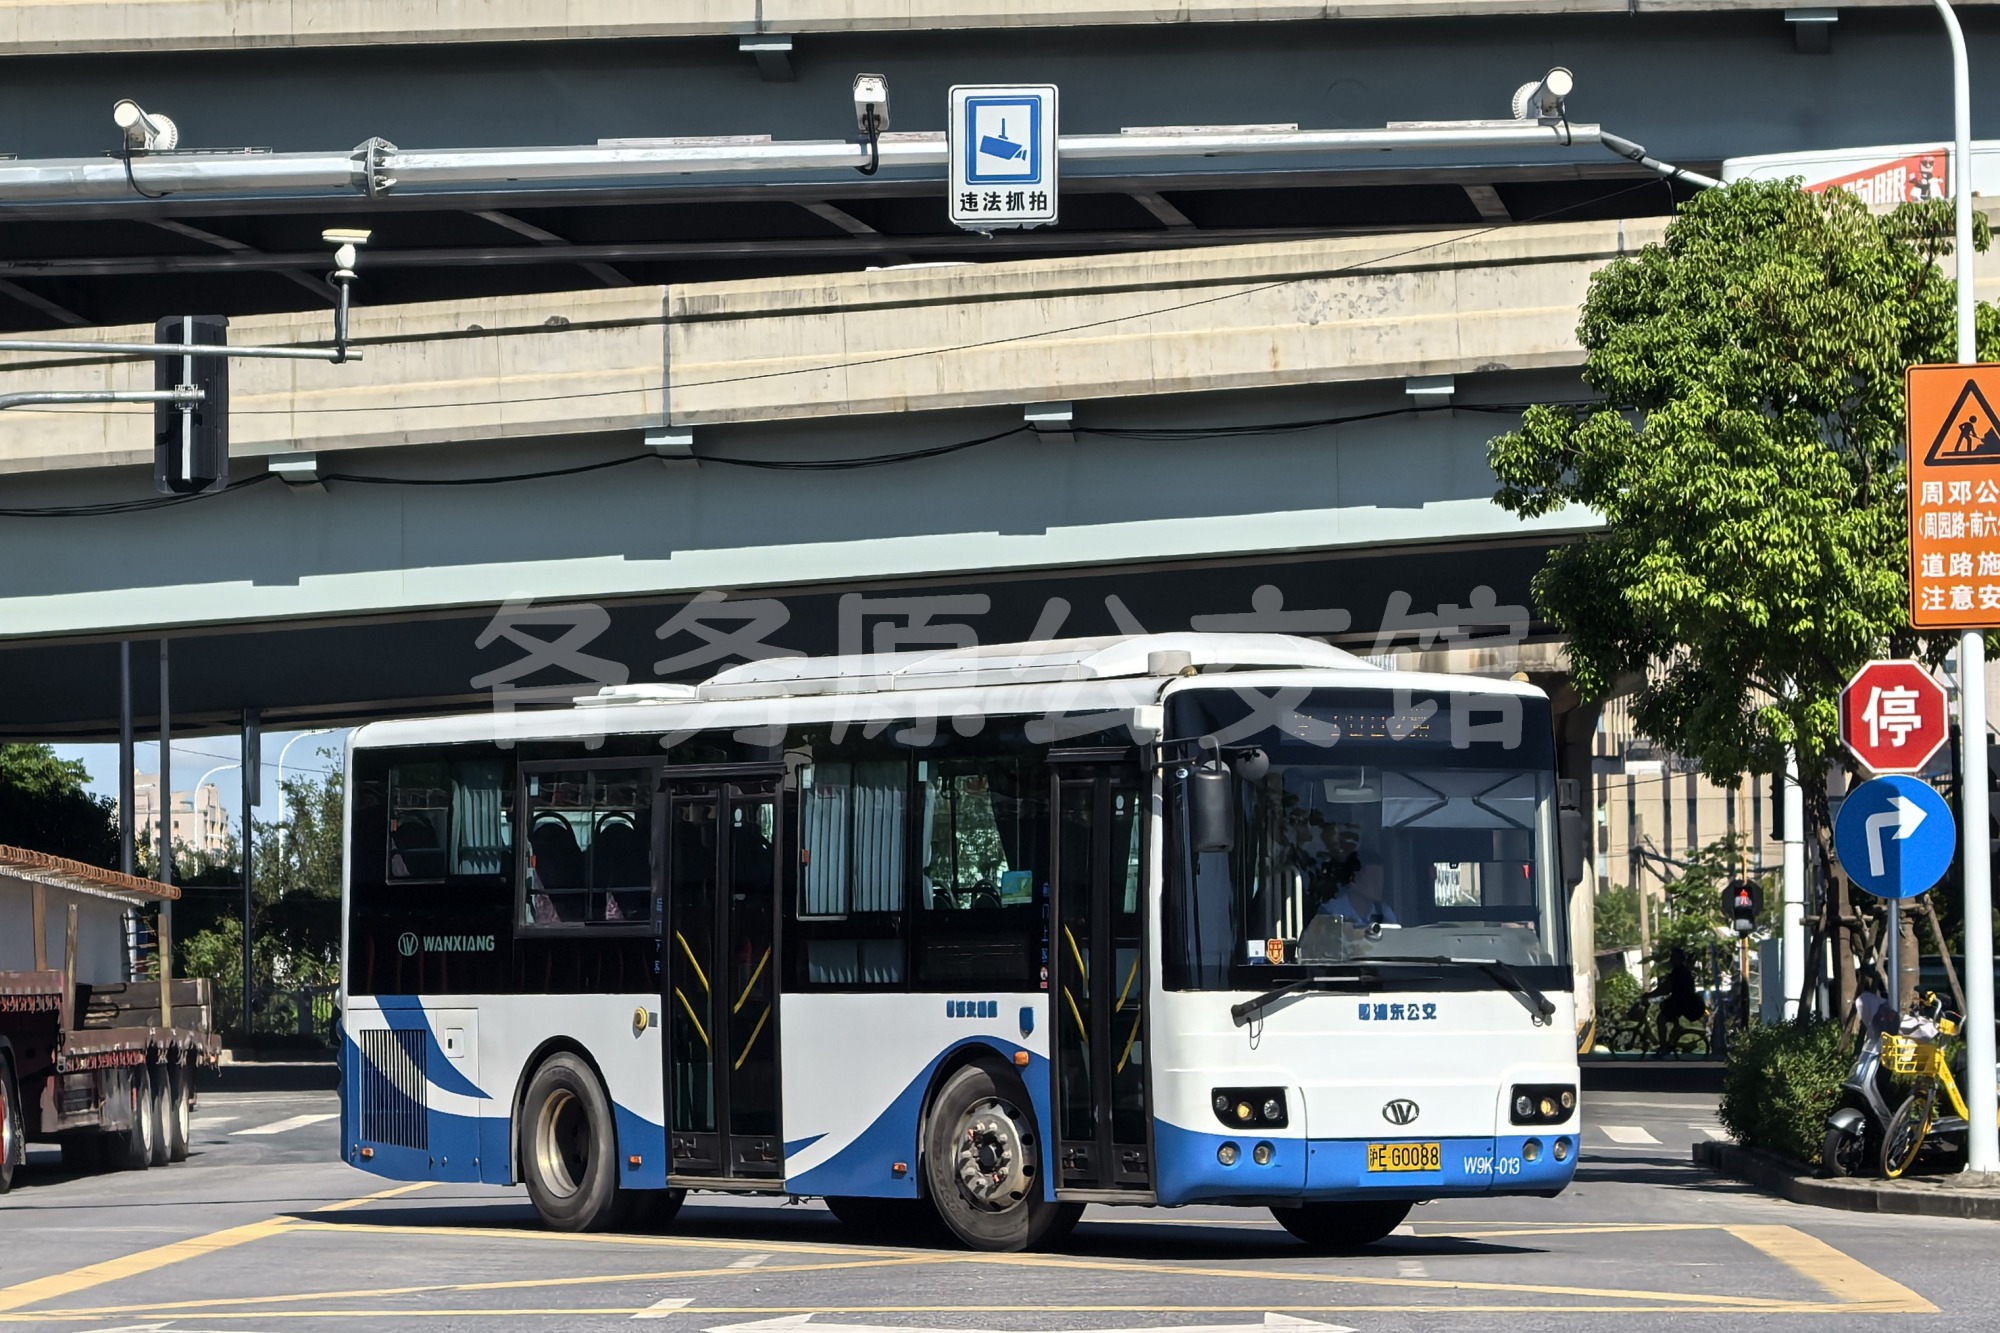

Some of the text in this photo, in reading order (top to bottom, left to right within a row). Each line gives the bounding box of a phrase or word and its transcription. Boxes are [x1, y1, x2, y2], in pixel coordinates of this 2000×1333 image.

[960, 190, 1048, 212] 违法抓拍
[1920, 479, 2000, 506] 周邓公
[1918, 510, 2000, 540] (周园路-南六
[1920, 551, 2000, 578] 道路施
[1920, 584, 2000, 611] 注意安
[1861, 685, 1922, 748] 停
[423, 935, 495, 952] WANXIANG
[1463, 1156, 1520, 1175] W9K-013
